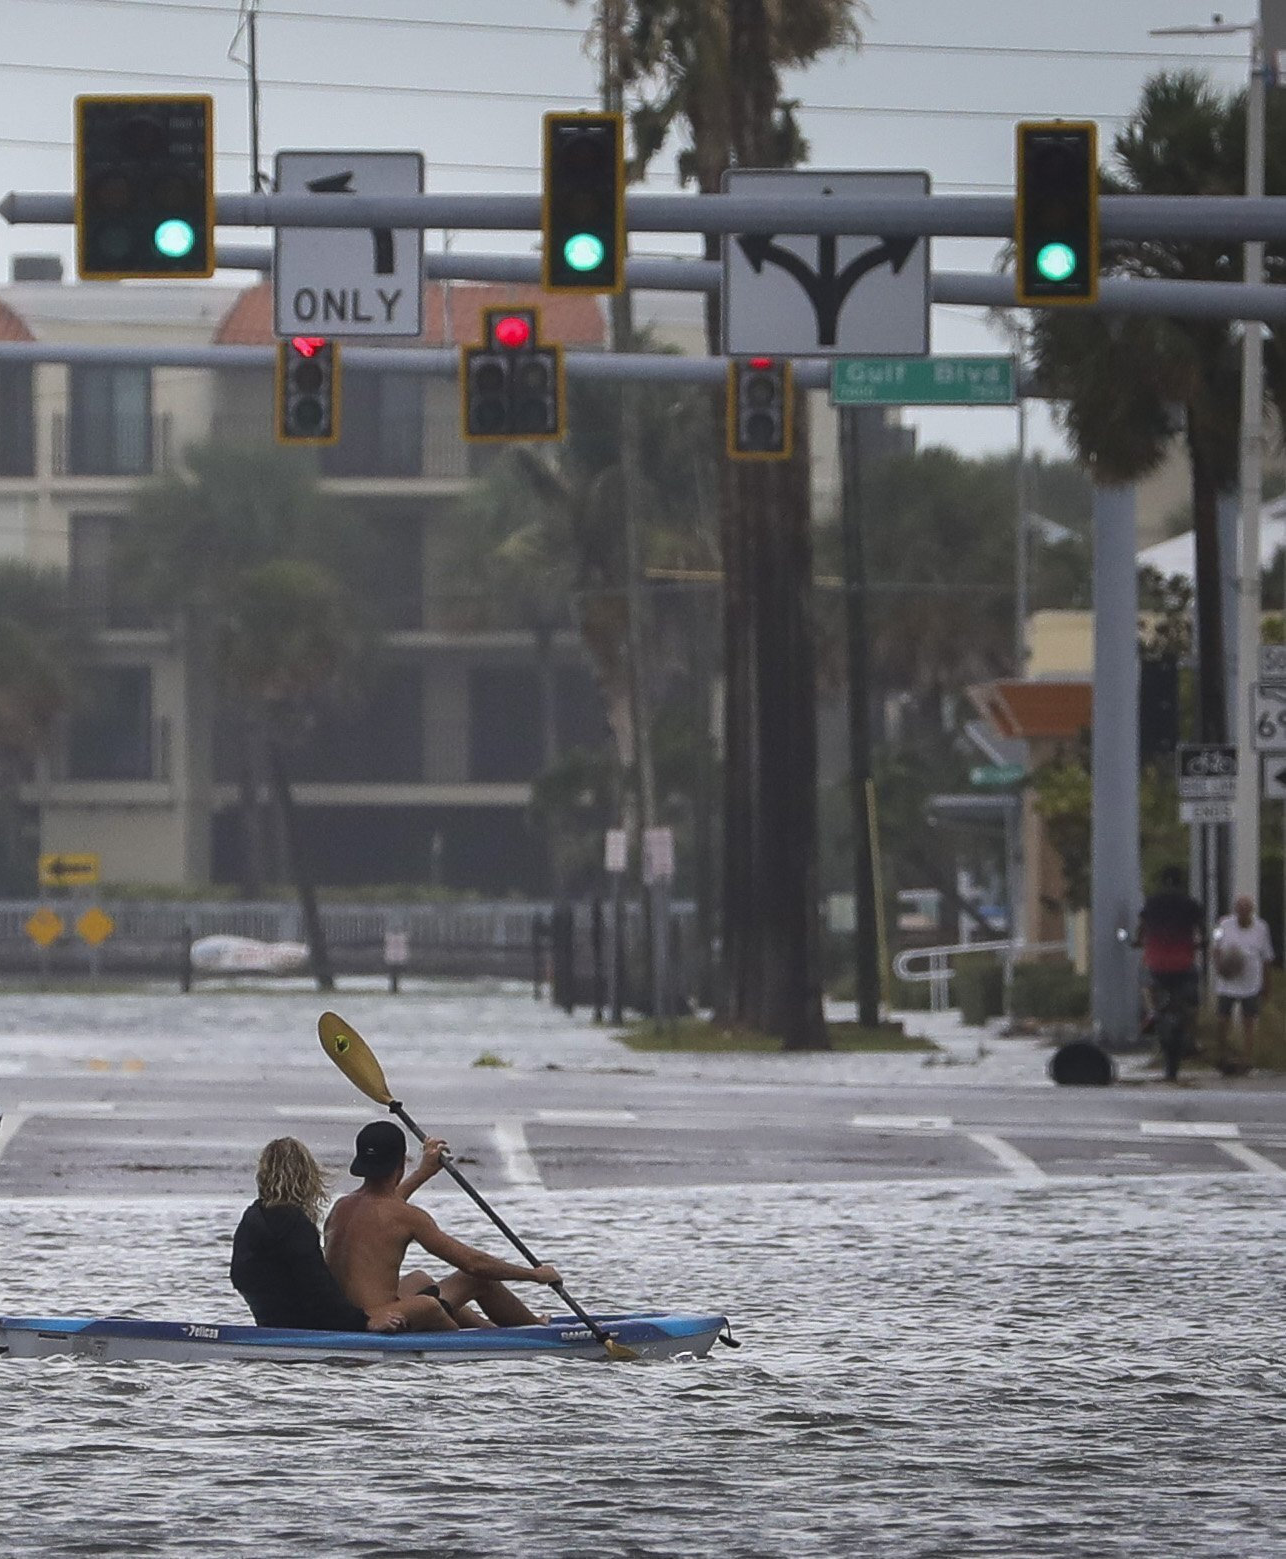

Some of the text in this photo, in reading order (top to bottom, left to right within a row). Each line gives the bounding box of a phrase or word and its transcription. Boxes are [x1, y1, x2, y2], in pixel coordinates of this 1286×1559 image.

[294, 287, 403, 322] ONLY
[846, 361, 1000, 385] Gulf Blvd
